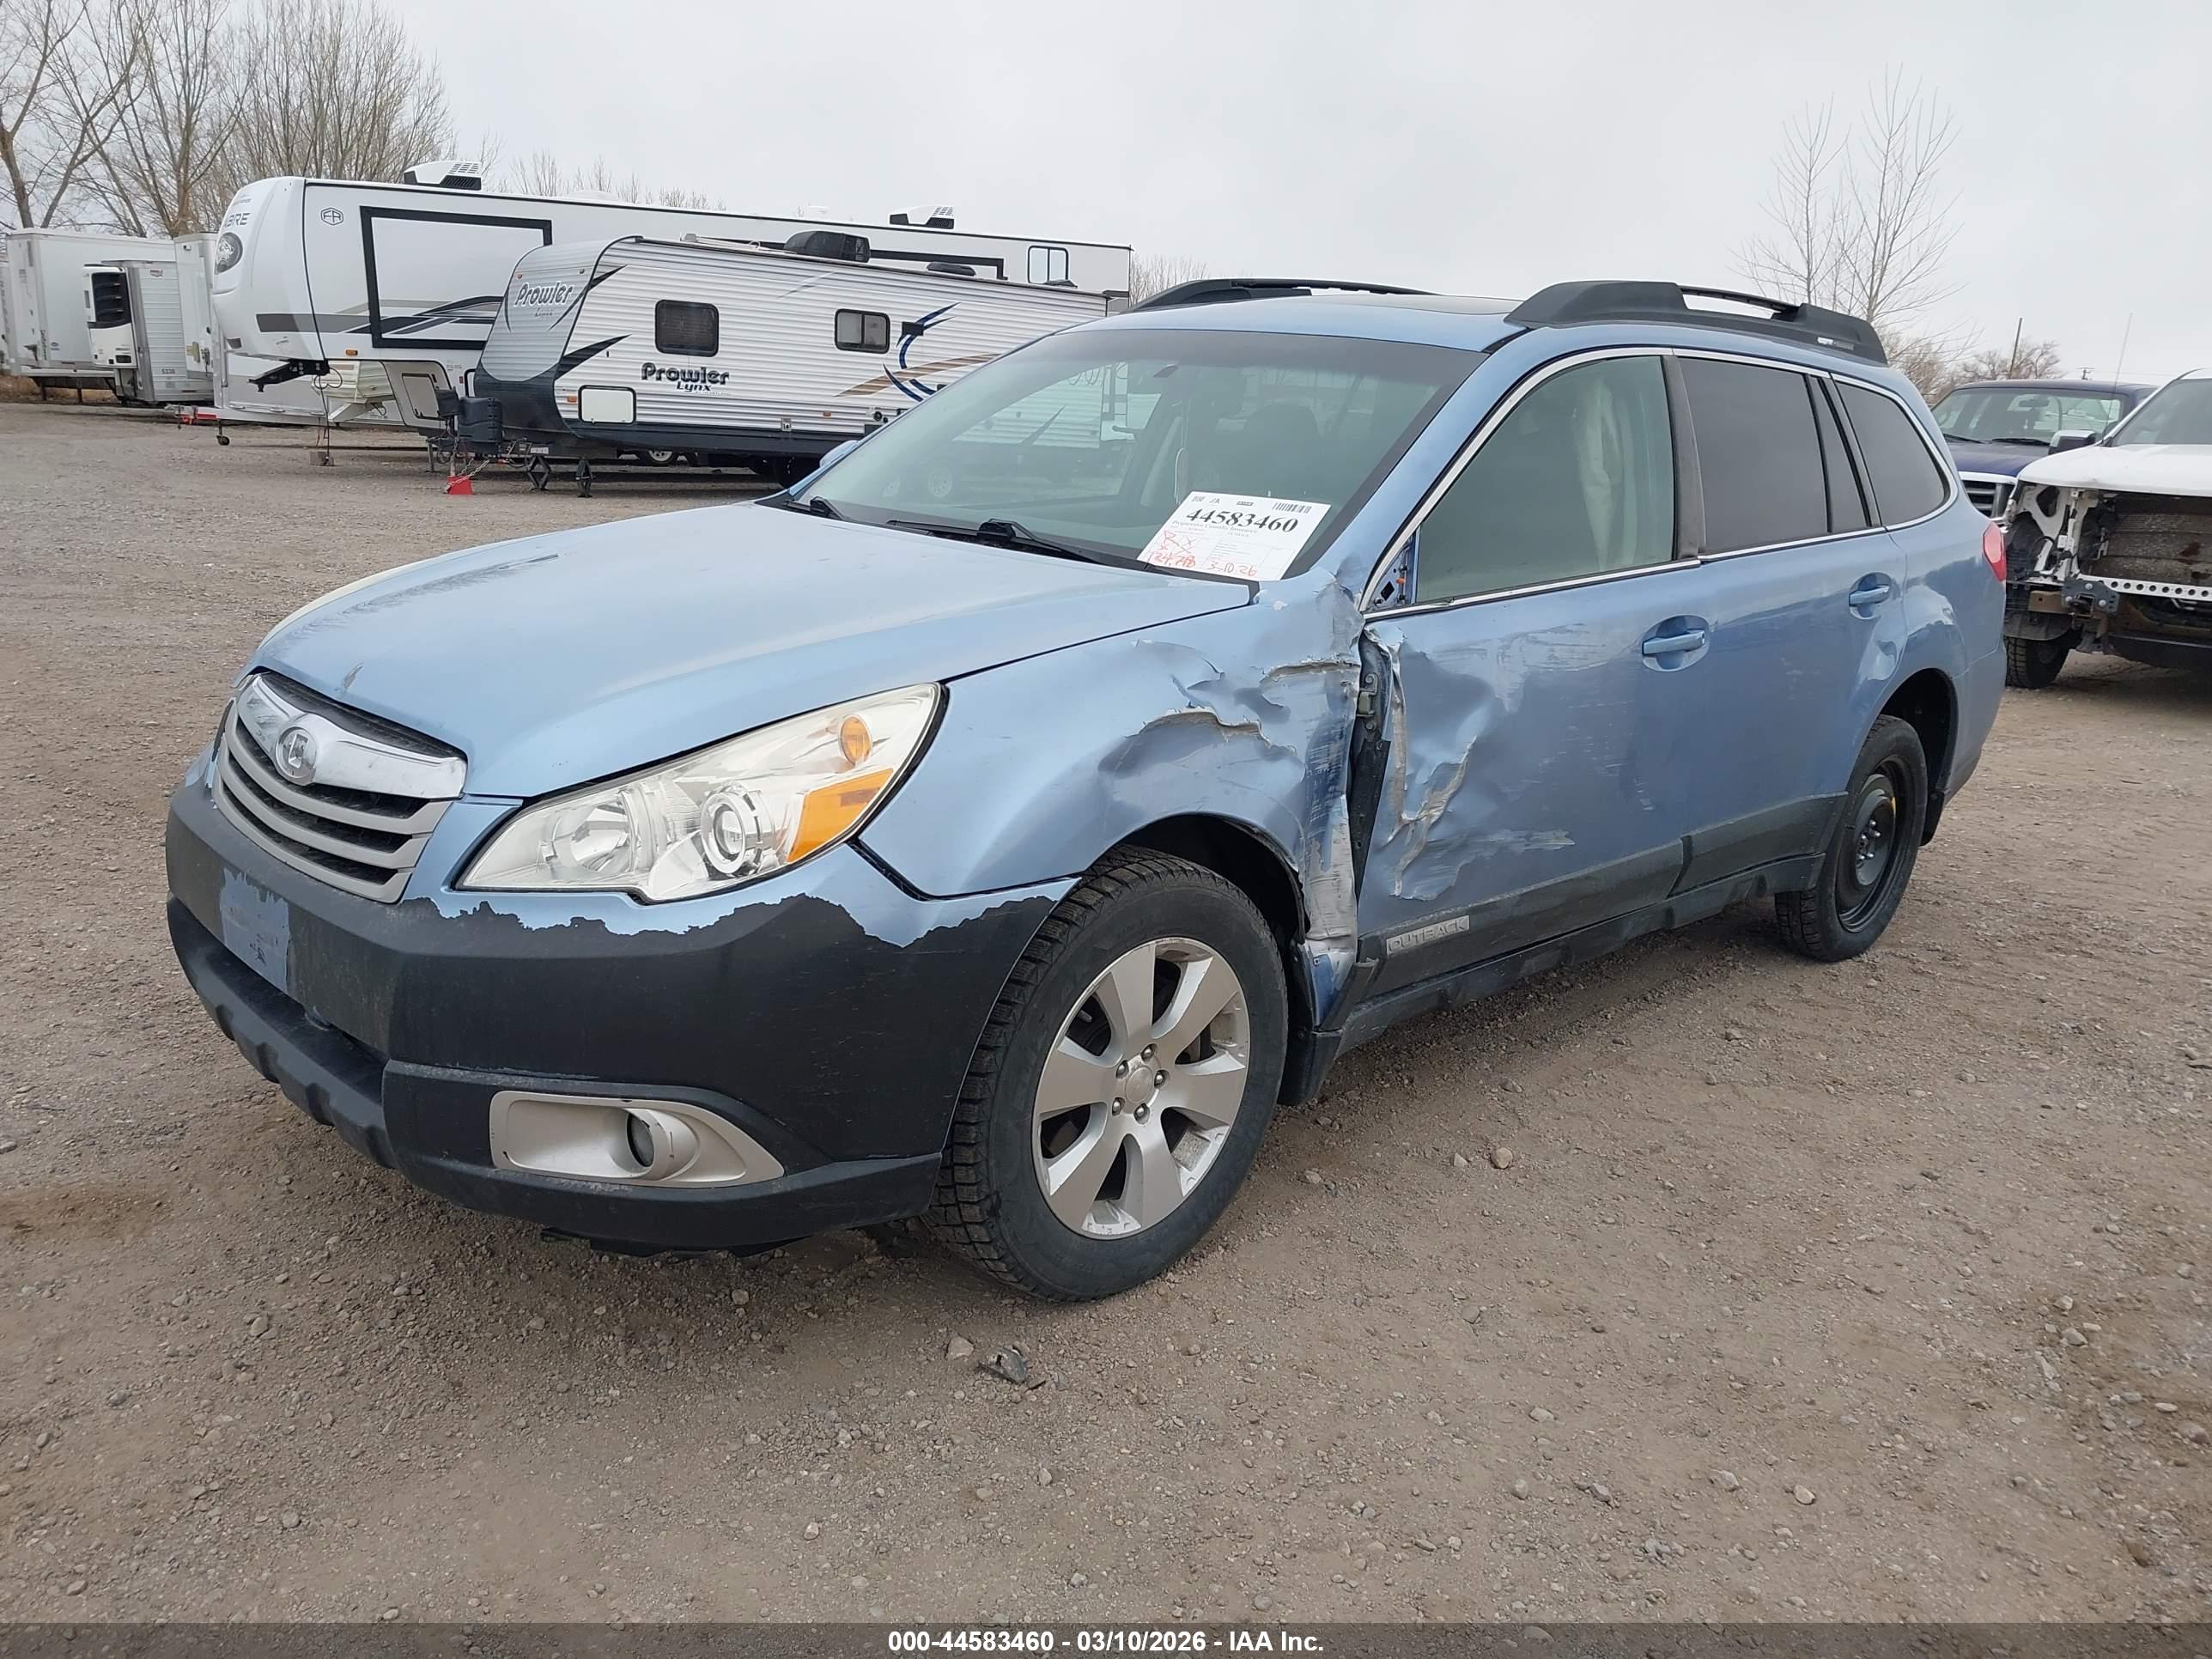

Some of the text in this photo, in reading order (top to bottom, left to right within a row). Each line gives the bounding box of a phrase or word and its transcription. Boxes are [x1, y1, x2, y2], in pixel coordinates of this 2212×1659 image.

[514, 281, 574, 307] Prowler
[641, 362, 730, 385] Prowler
[676, 380, 712, 392] Lynx
[1186, 508, 1298, 533] 44583460
[1388, 916, 1466, 952] OUTBACK
